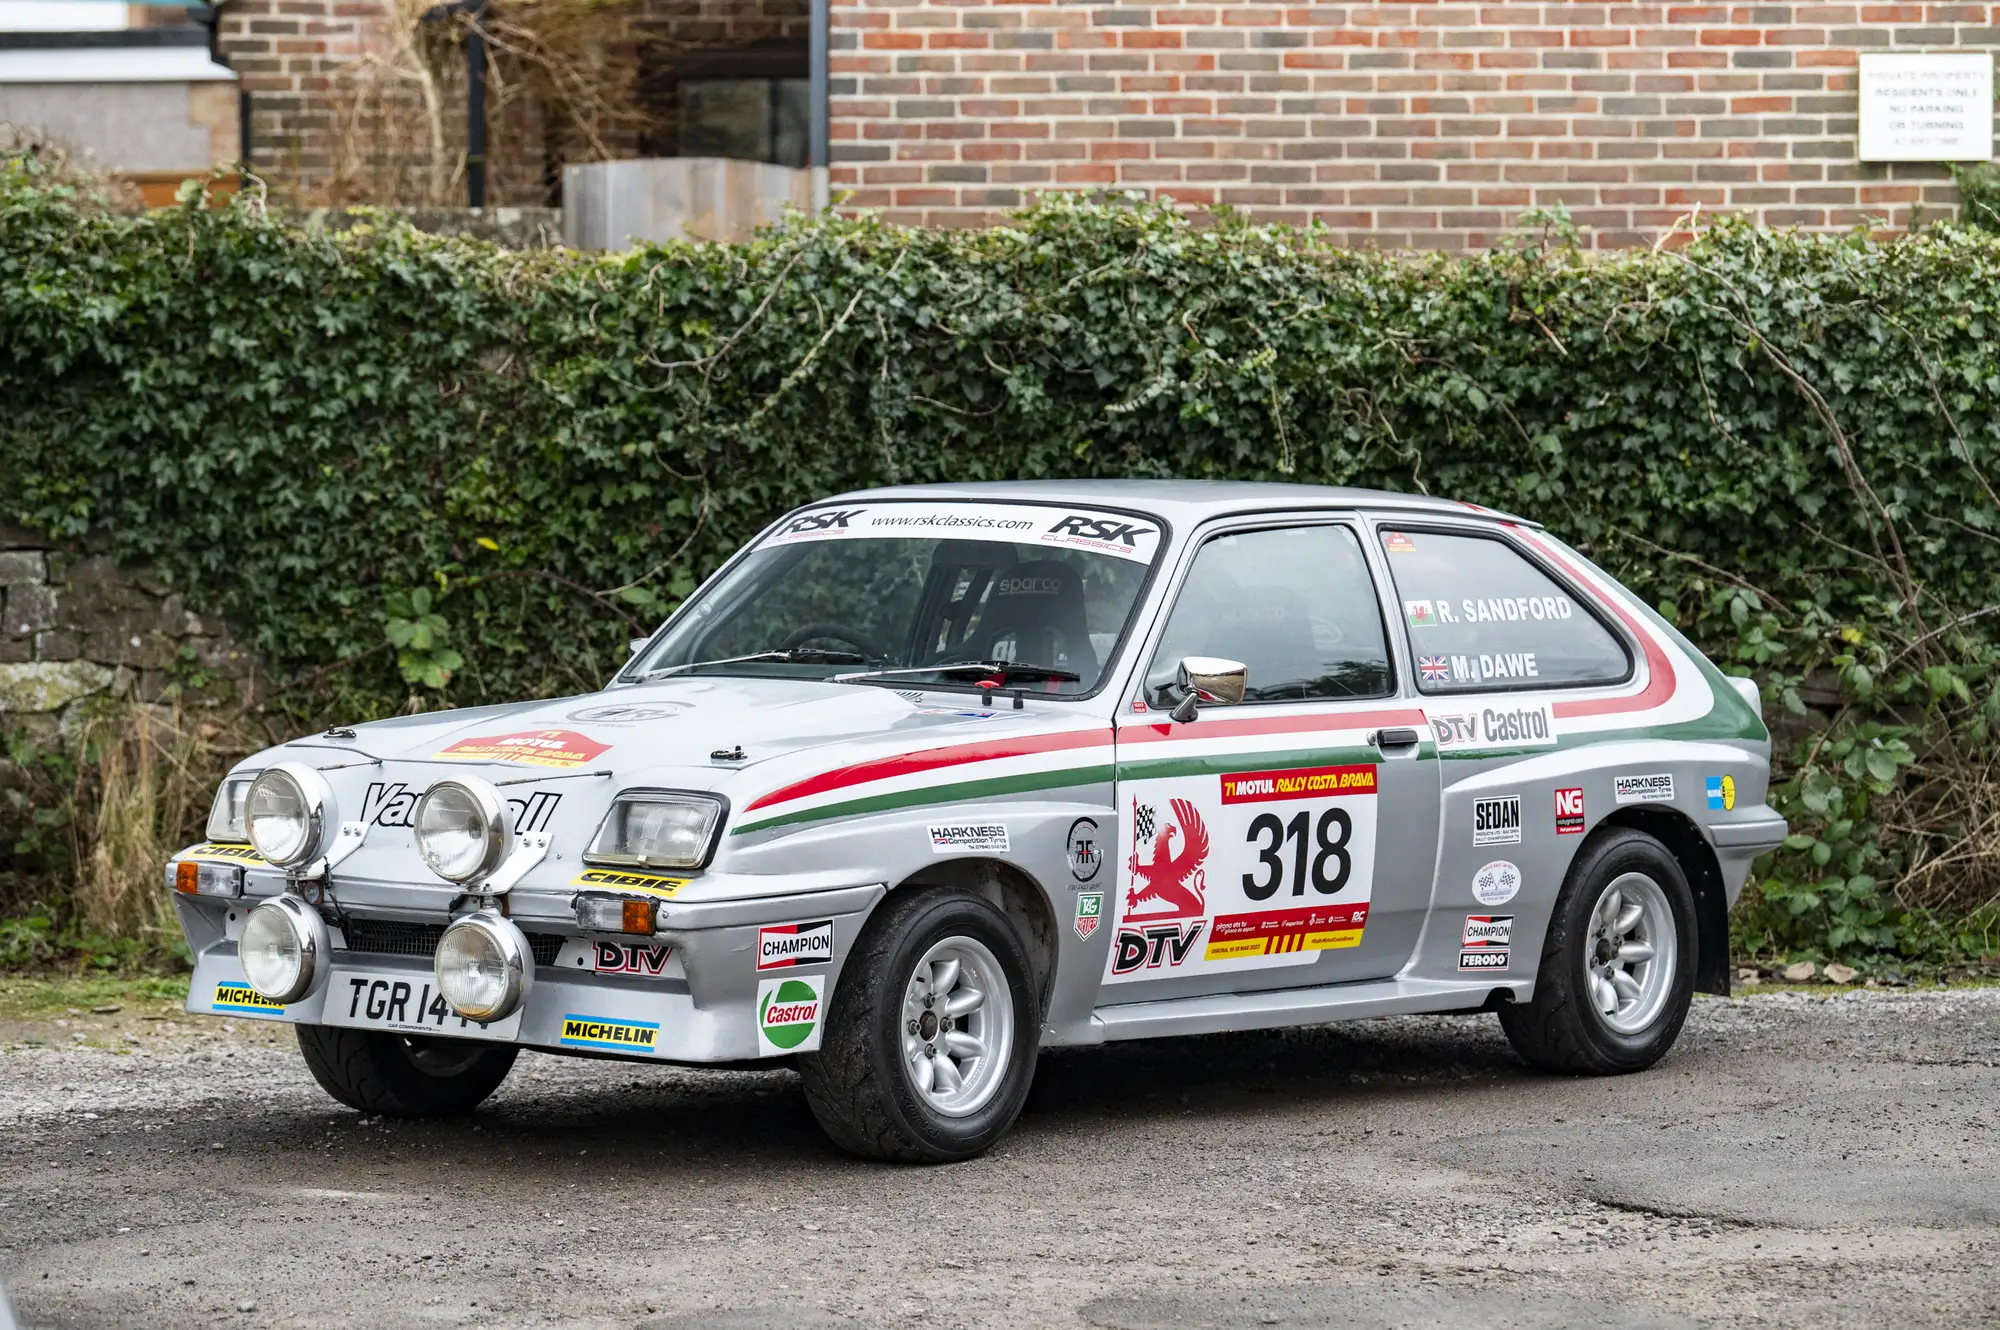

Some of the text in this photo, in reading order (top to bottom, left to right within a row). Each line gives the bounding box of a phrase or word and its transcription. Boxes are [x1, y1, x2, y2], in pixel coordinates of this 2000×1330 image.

[1875, 87, 1978, 97] RESIDENTS ONLY
[1889, 104, 1965, 113] NO PARKING
[1888, 120, 1965, 130] OR TURNING
[775, 510, 868, 537] RSK
[871, 514, 1034, 530] www.rskclassics.com
[1047, 515, 1157, 547] RSK
[1041, 534, 1134, 554] CLASSICS
[1000, 578, 1061, 595] sparco
[1436, 596, 1572, 624] R. SANDFORD
[1450, 653, 1539, 680] M. DAWE
[1430, 707, 1549, 745] DTV Castrol
[1225, 772, 1374, 797] 71 MOTUL RALLY COSTA BRAVA
[1617, 776, 1671, 789] HARKNESS
[1628, 787, 1657, 795] Competition
[1556, 790, 1583, 816] NG
[1476, 800, 1519, 830] SEDAN
[930, 826, 1005, 838] HARKNESS
[948, 837, 988, 845] Competition
[1242, 808, 1352, 901] 318
[580, 872, 682, 891] CIBIE
[1082, 897, 1097, 914] TAG
[1078, 917, 1098, 934] HEUER
[1467, 926, 1509, 938] CHAMPION
[763, 935, 829, 956] CHAMPION
[1112, 920, 1207, 975] DTV
[593, 941, 672, 975] DTV
[1462, 953, 1506, 966] FERODO
[349, 979, 411, 1022] TGR
[767, 1003, 818, 1024] Castrol
[565, 1022, 652, 1043] MICHELIN
